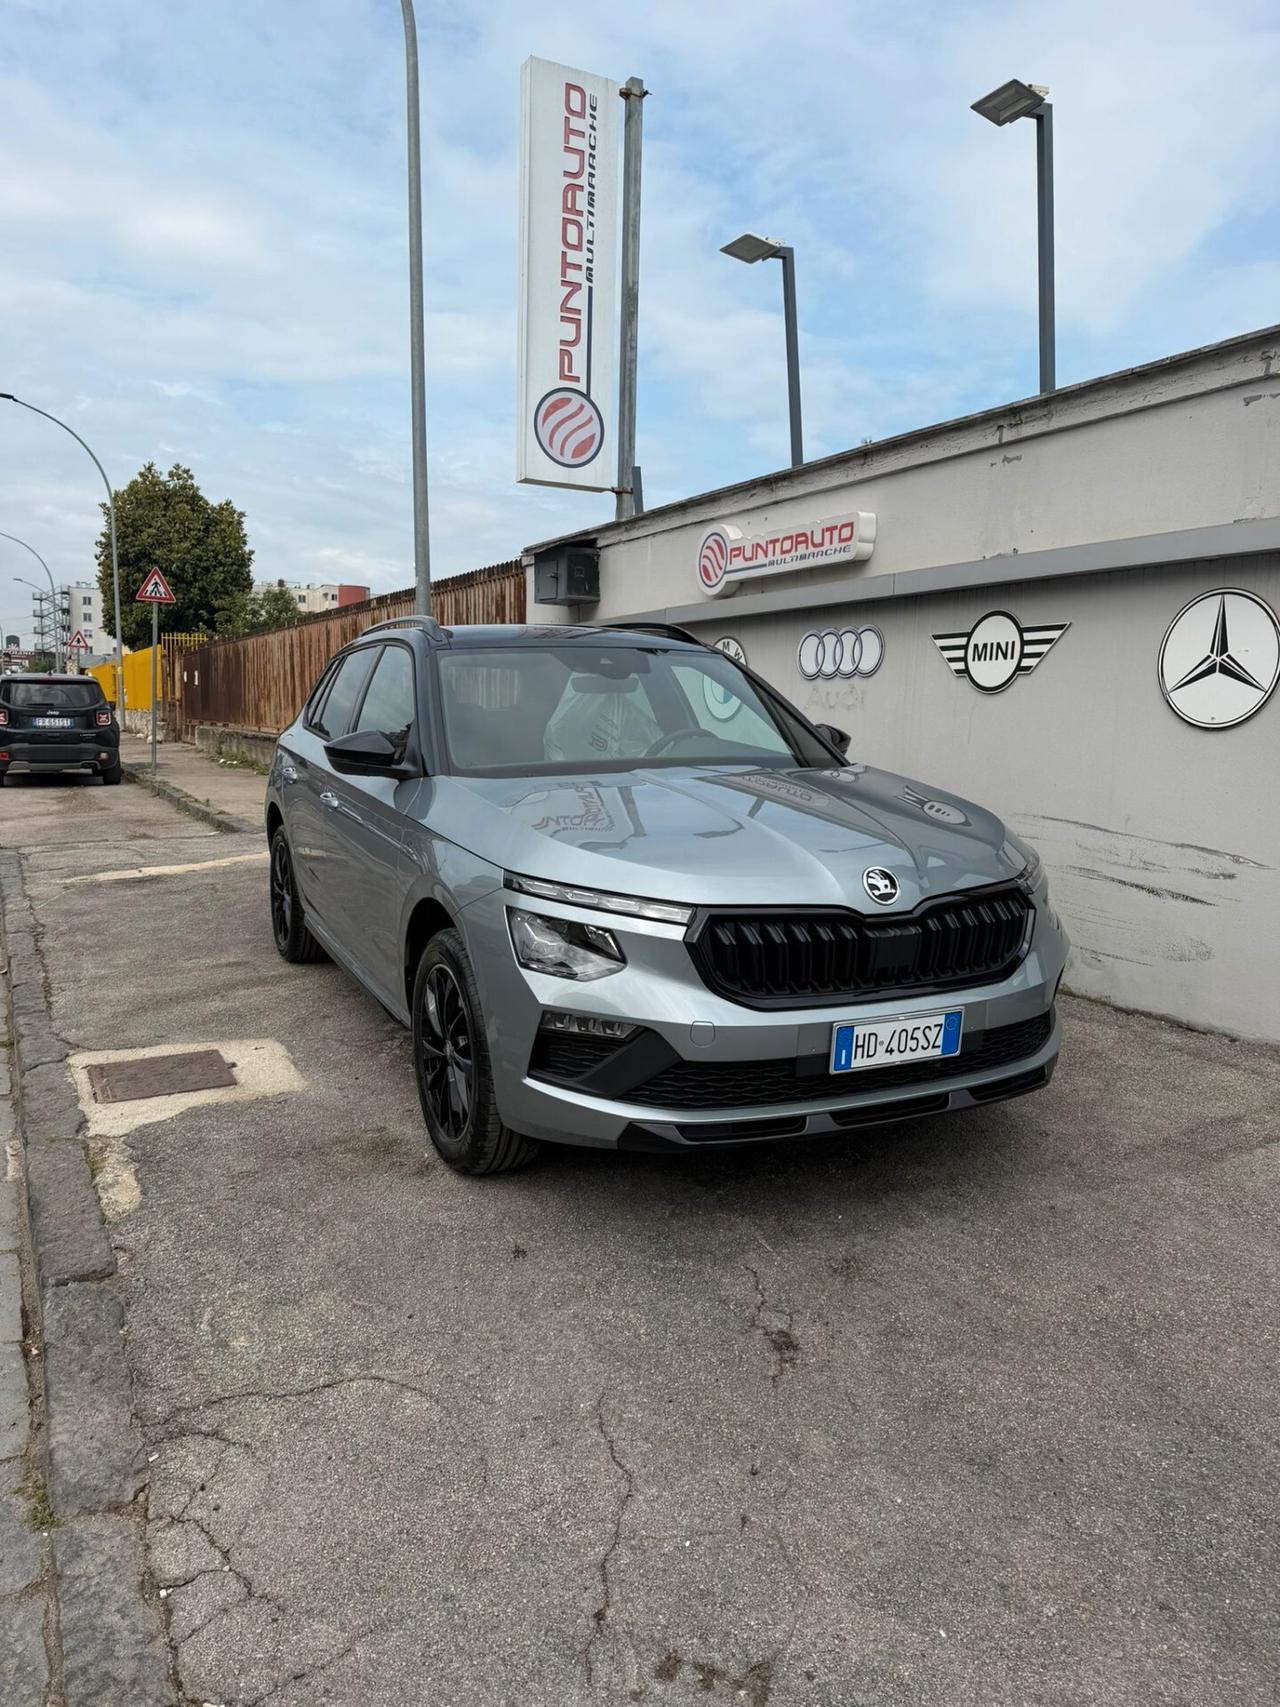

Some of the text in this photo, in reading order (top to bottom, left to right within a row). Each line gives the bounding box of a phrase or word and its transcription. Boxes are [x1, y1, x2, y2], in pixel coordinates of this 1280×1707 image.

[585, 93, 598, 284] MULTIMARCHE
[559, 82, 587, 383] PUNTOAUTO
[729, 521, 855, 565] PUNTOAUTO
[767, 544, 852, 567] MULTIMARCHE
[971, 640, 1016, 662] MINI
